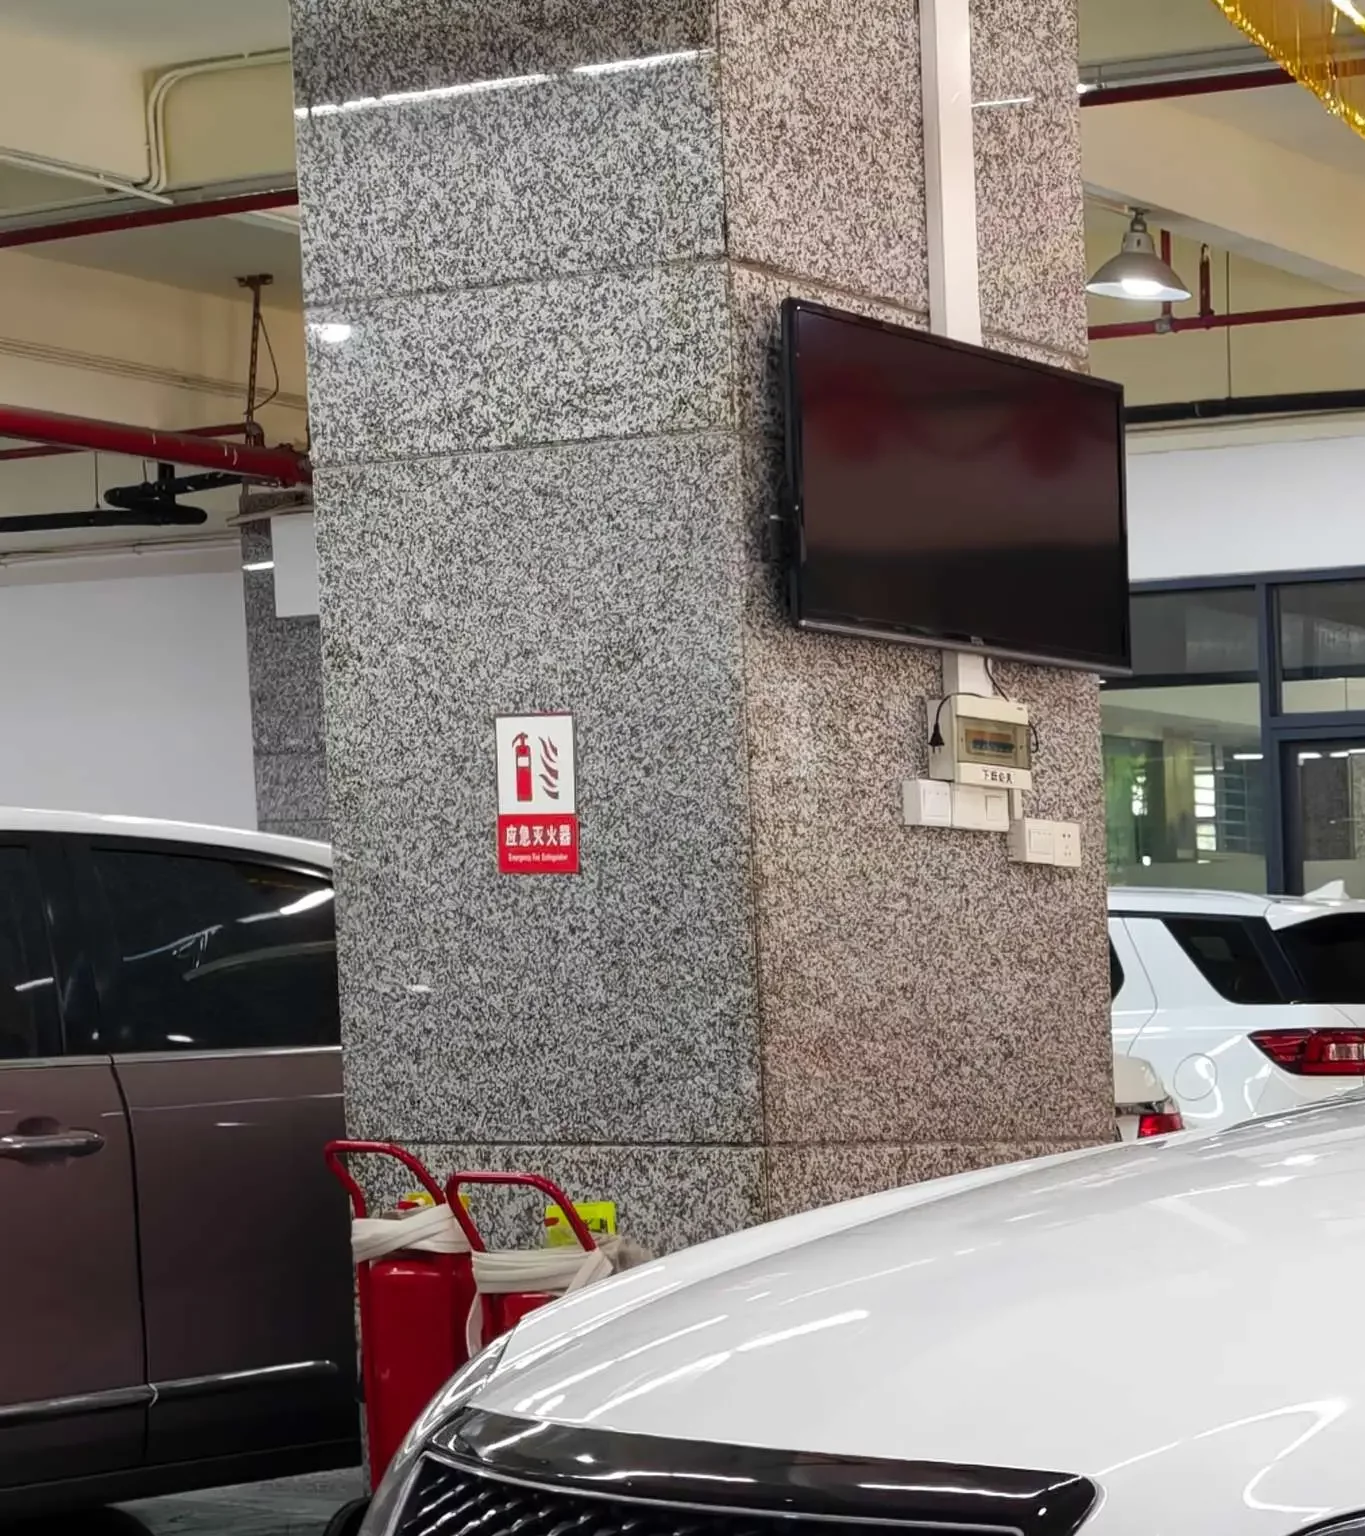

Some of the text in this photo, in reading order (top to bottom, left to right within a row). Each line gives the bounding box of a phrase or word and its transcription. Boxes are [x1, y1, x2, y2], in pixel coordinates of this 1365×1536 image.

[506, 824, 571, 846] 应急灭火器
